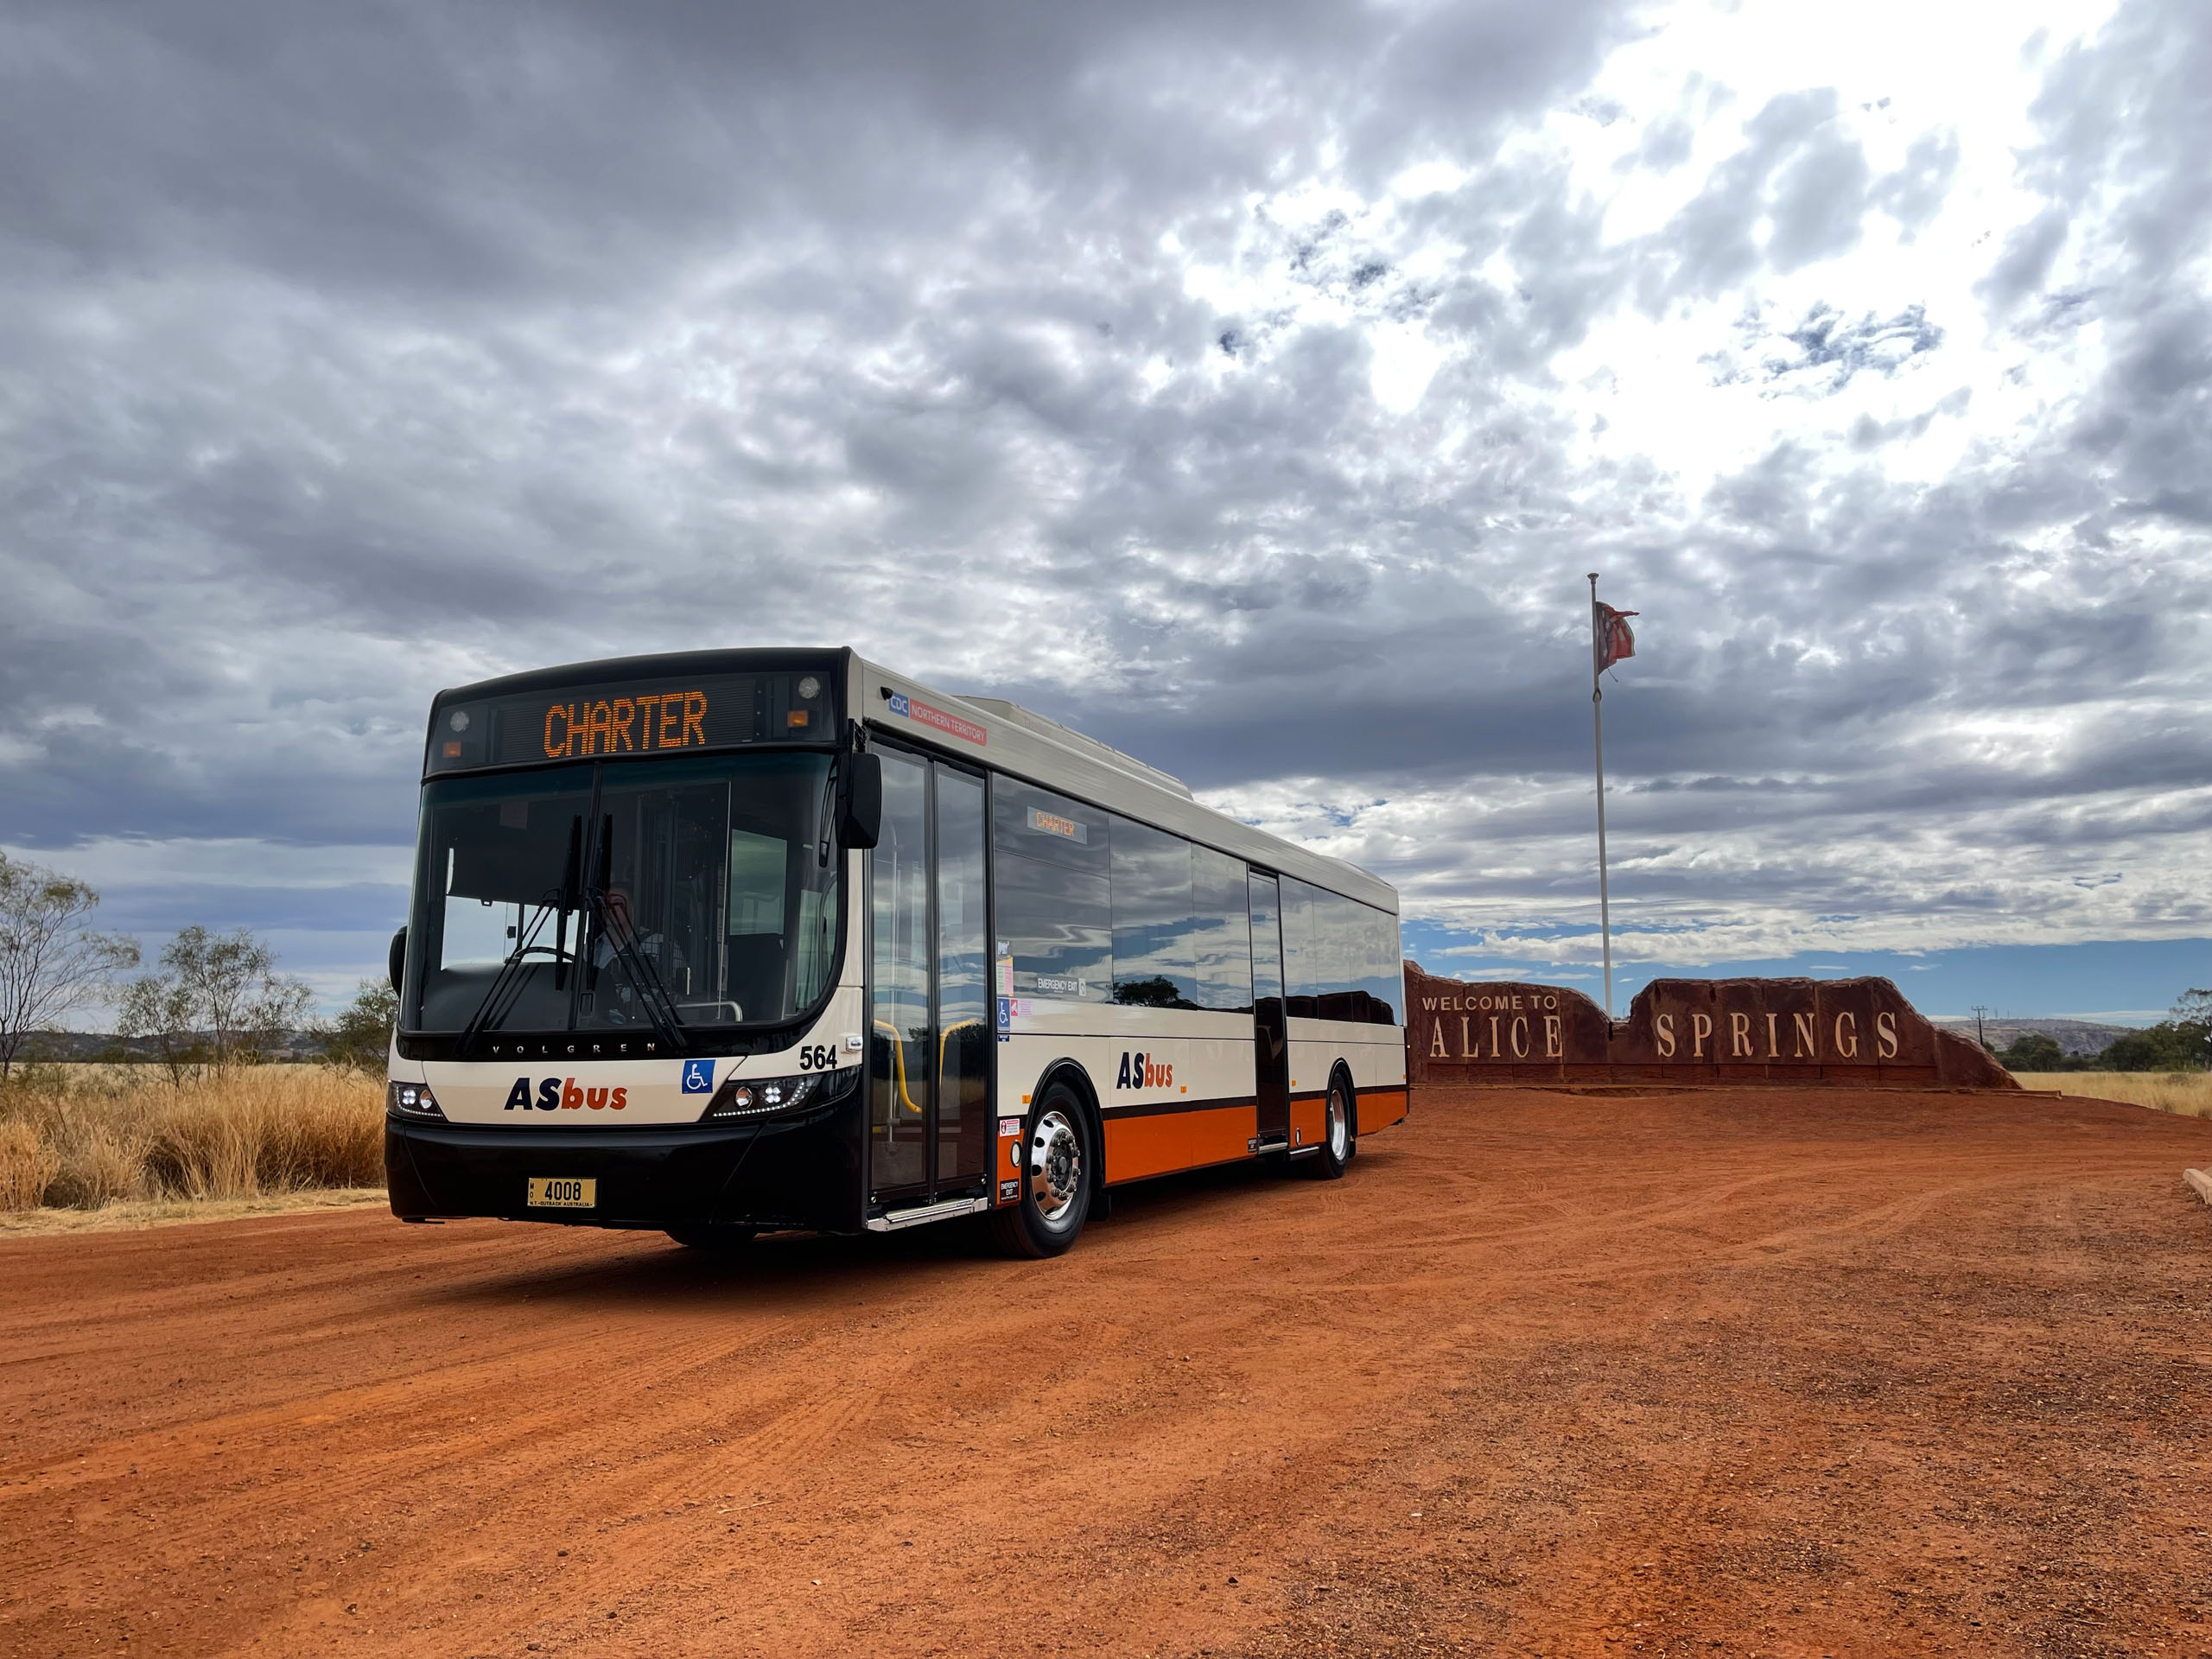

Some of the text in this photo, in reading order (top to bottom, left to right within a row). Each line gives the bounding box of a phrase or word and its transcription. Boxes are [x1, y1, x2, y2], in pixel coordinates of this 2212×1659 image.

[890, 696, 908, 714] CDC
[543, 690, 708, 759] CHARTER
[911, 703, 986, 742] NORTHERN TERRITORY
[1036, 810, 1076, 837] CHARTER
[1038, 977, 1078, 993] EMERGENCY EXIT
[1421, 995, 1558, 1011] WELCOME TO
[493, 1042, 656, 1055] VOLGREN
[1429, 1011, 1900, 1059] ALICE SPRINGS
[799, 1044, 838, 1071] 564
[1116, 1052, 1173, 1090] ASbus
[504, 1077, 628, 1111] ASbus
[544, 1181, 582, 1201] 4008
